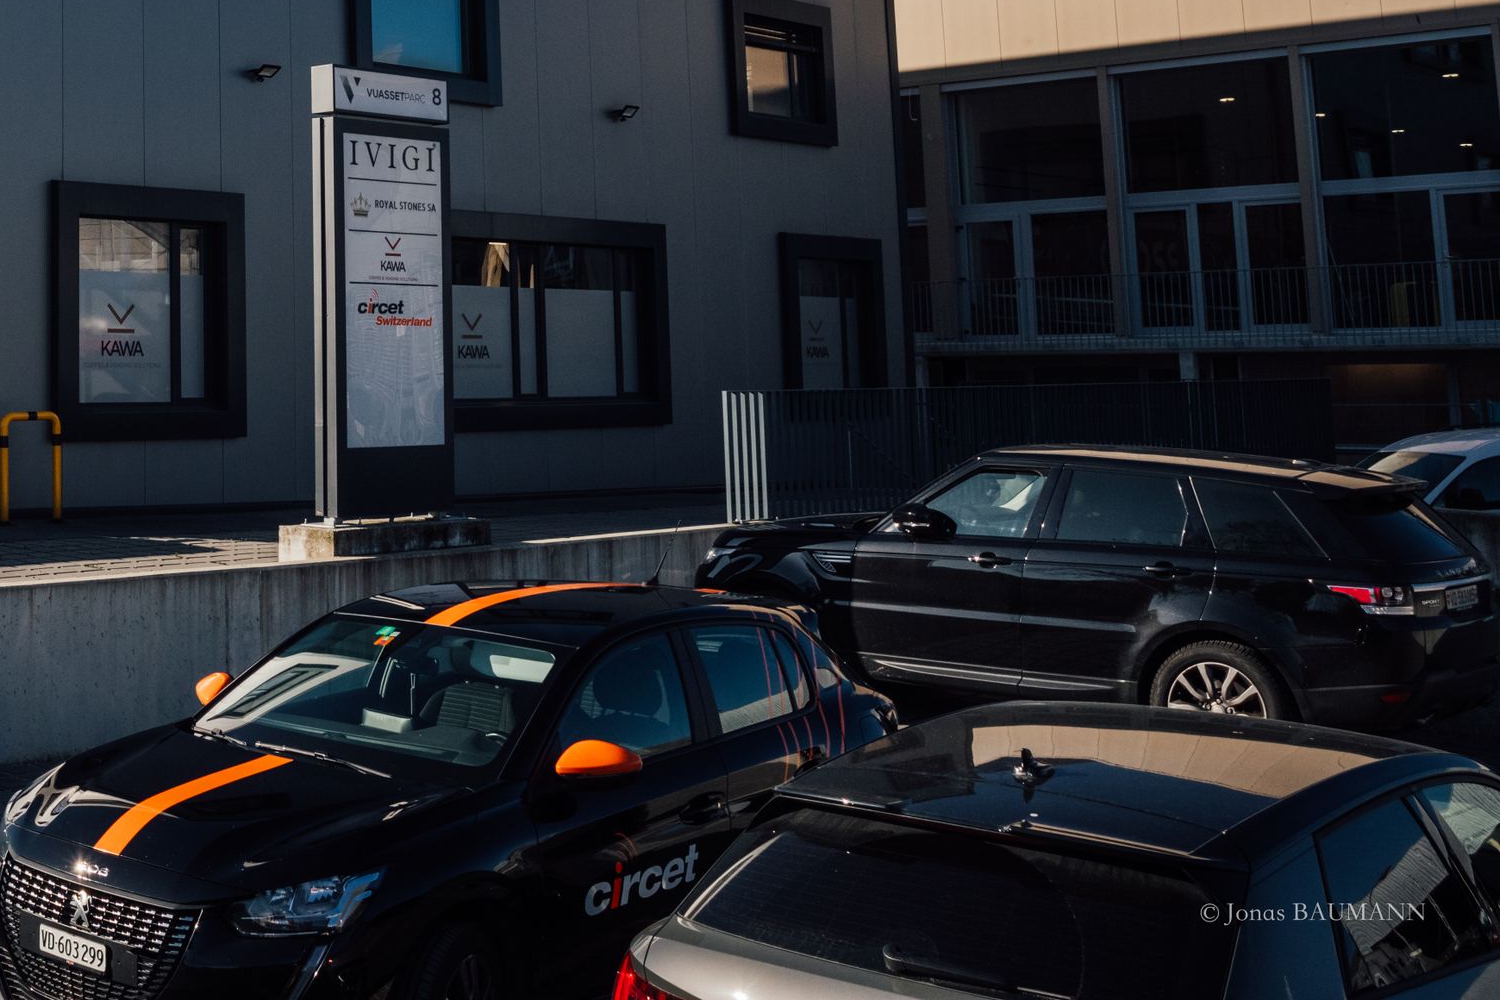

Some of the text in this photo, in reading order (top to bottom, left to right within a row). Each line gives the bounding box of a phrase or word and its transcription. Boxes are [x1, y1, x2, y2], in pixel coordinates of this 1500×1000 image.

[432, 88, 442, 106] 8
[374, 199, 436, 212] ROYAL STONES SA
[380, 260, 406, 272] KAWA
[357, 298, 404, 314] circet
[375, 315, 433, 327] Switzerland
[101, 340, 144, 357] KAWA
[458, 344, 490, 359] KAWA
[805, 346, 830, 359] KAWA
[584, 843, 699, 917] circet
